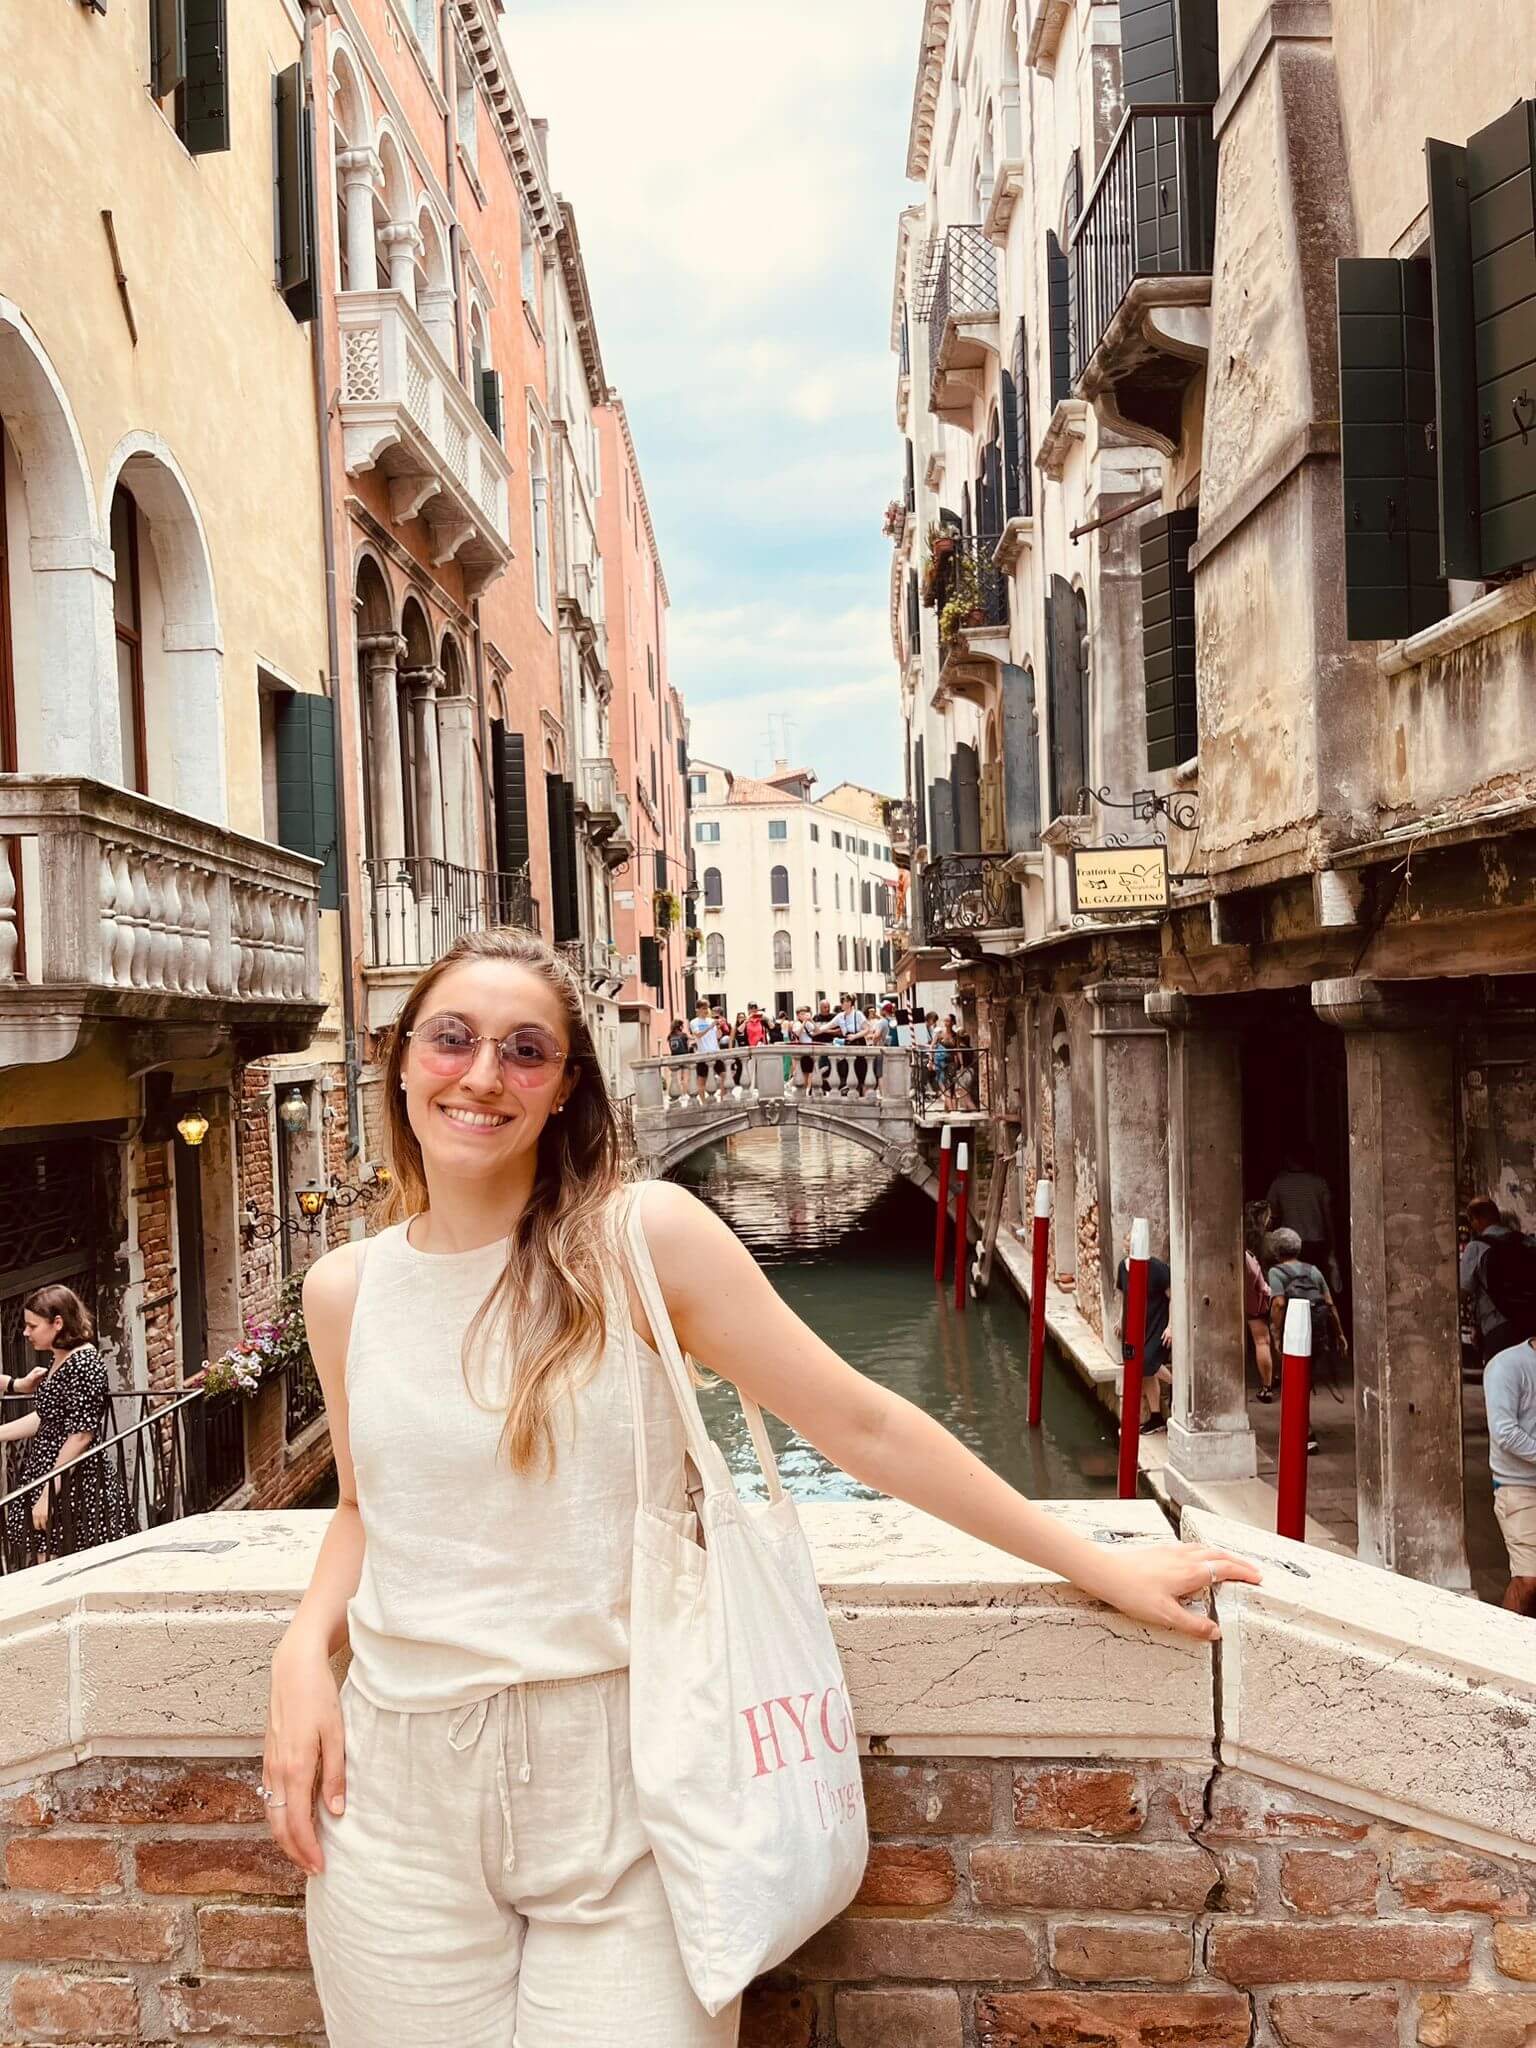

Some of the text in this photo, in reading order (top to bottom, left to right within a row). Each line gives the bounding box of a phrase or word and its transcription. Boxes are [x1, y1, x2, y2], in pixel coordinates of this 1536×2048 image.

[1077, 868, 1116, 877] Trattoria
[1079, 894, 1164, 905] AL GAZZETTINO
[739, 1681, 856, 1778] HYG
